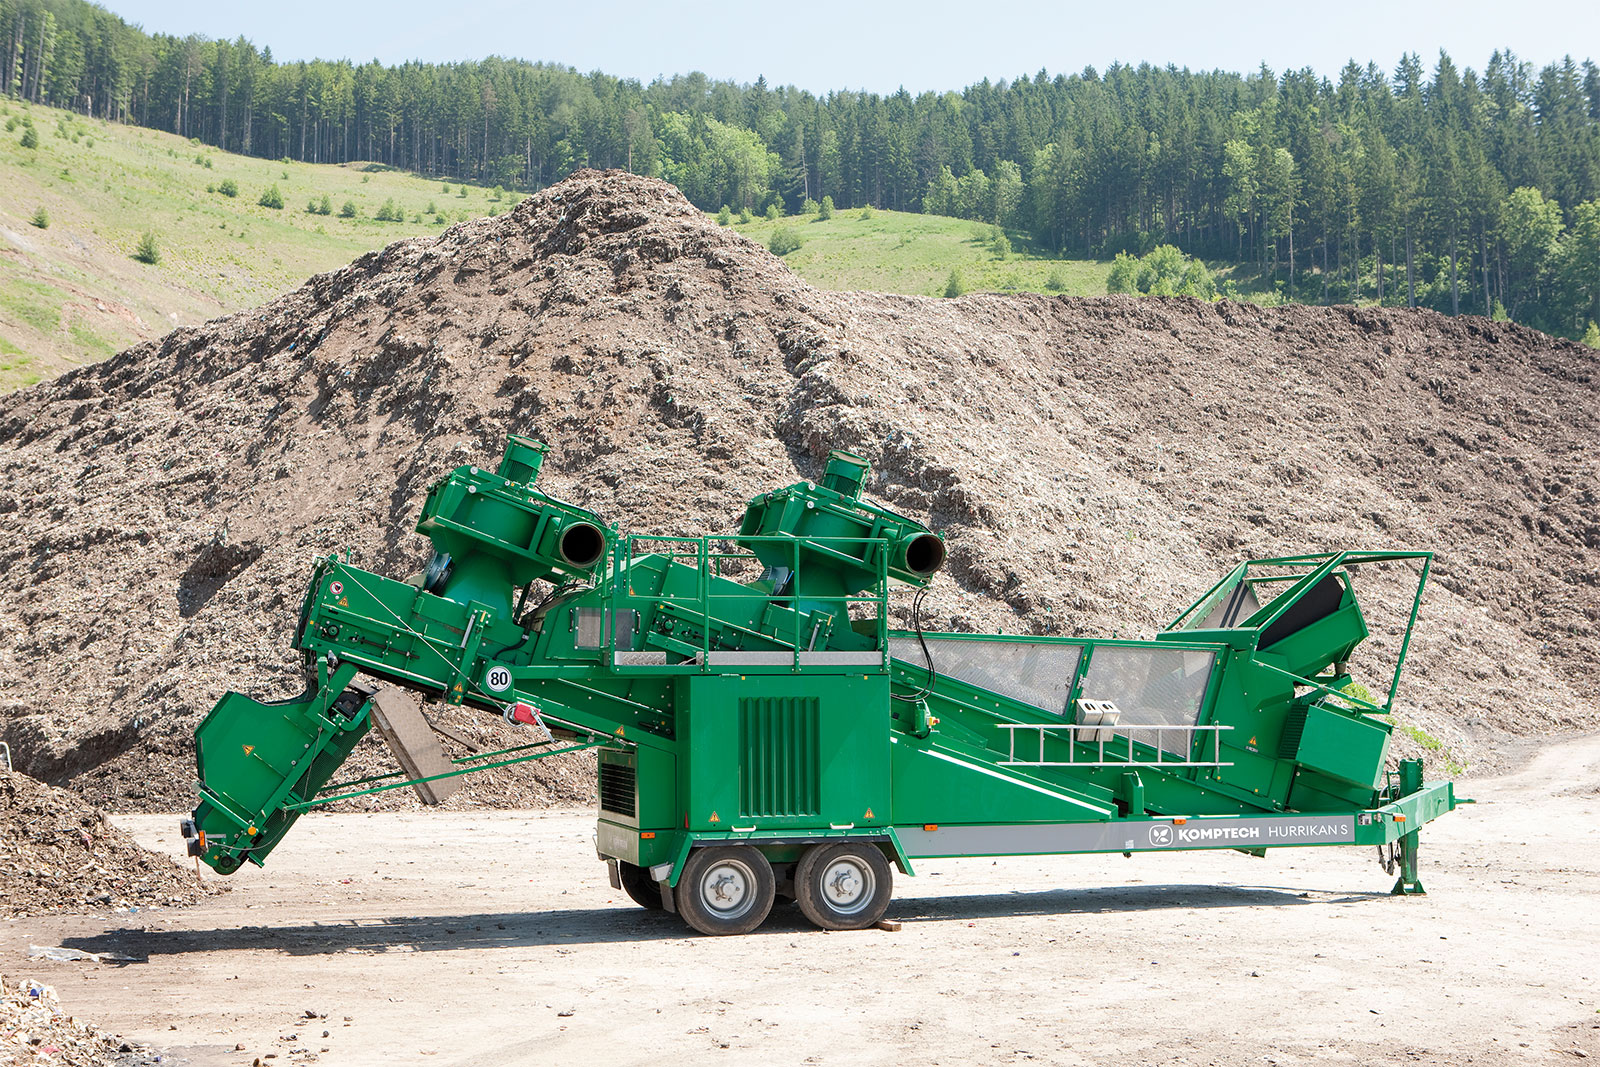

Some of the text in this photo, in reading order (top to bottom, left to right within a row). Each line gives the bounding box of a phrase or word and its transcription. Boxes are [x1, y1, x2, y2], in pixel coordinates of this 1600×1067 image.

[490, 671, 508, 686] 80
[1178, 824, 1348, 843] KOMPTECH HURRIKAN S
